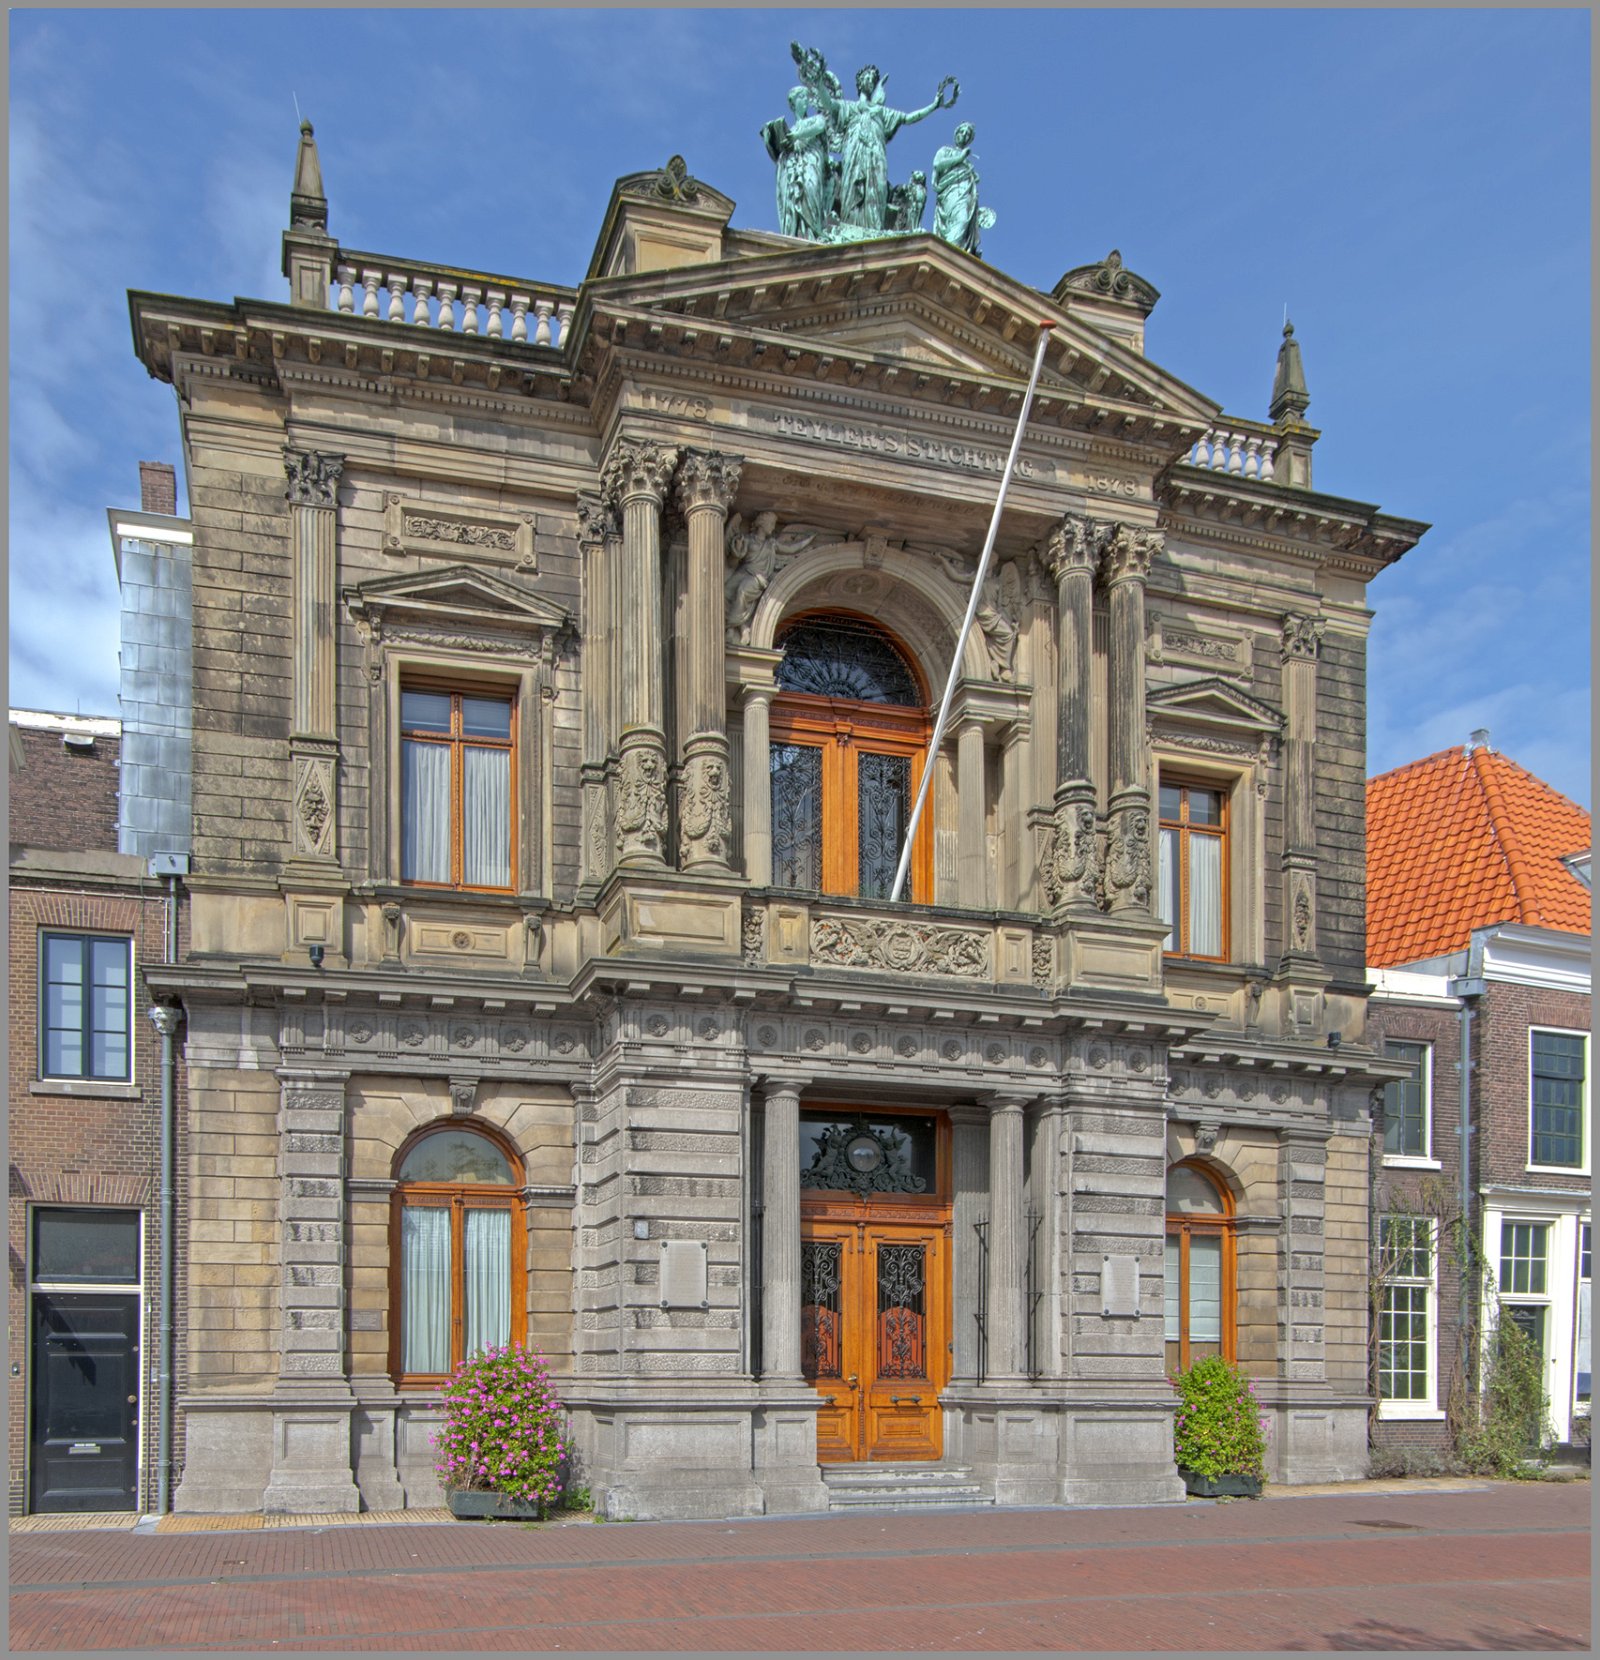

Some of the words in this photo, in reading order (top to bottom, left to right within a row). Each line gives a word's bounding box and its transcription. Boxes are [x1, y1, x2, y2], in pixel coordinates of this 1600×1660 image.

[647, 391, 708, 419] 1778
[773, 413, 899, 452] TEYLER'S
[1086, 474, 1136, 496] 1878
